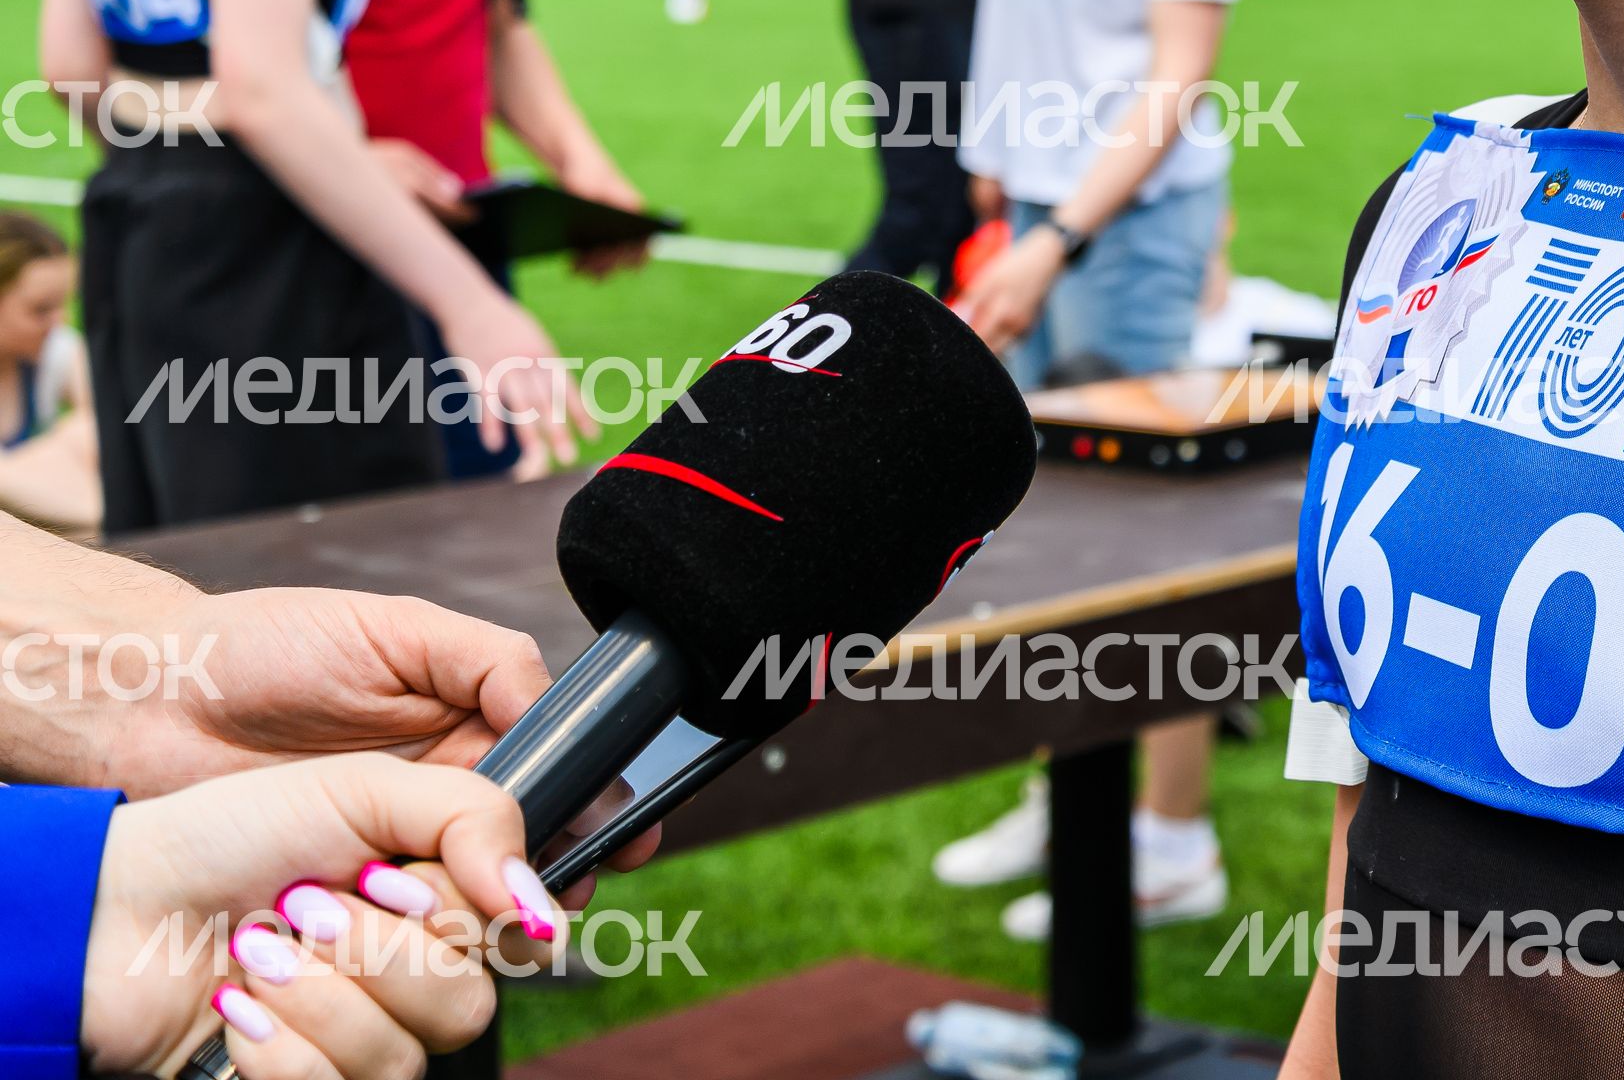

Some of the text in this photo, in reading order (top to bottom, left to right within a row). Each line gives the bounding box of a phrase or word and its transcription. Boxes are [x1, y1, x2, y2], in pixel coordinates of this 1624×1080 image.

[1573, 178, 1624, 197] МИНСПОРТ
[1564, 194, 1606, 212] РОССИИ
[720, 303, 852, 374] 60
[1554, 326, 1595, 350] лет
